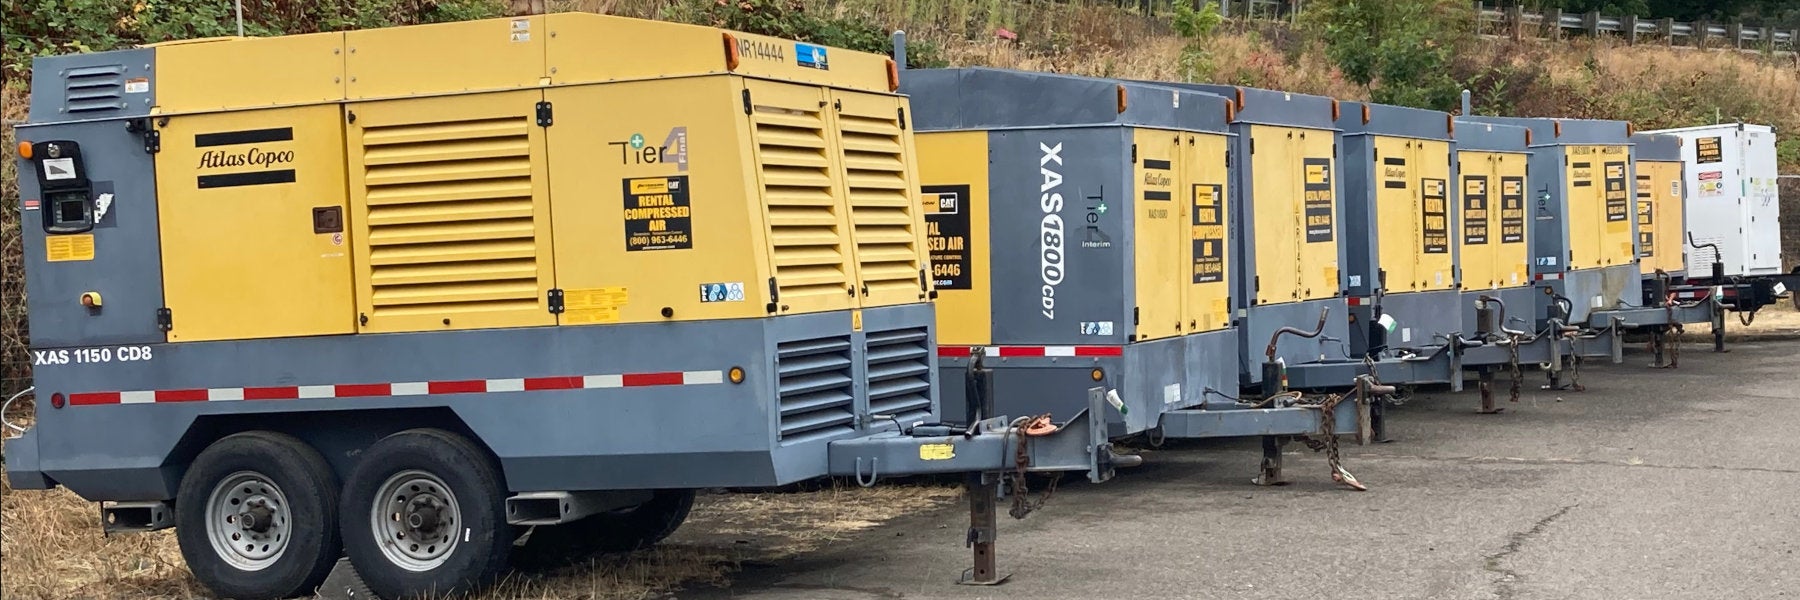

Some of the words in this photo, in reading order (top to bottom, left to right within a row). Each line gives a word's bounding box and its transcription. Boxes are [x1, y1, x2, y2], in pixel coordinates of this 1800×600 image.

[736, 38, 784, 62] NR14444
[608, 134, 667, 164] Tier
[196, 150, 246, 169] Atlas
[247, 148, 294, 168] Copco
[668, 181, 679, 190] CAT
[638, 194, 674, 207] RENTAL
[940, 198, 955, 208] CAT
[624, 206, 690, 220] COMPRESSED
[1086, 185, 1108, 232] Tier
[649, 219, 666, 231] AIR
[630, 236, 650, 246] (800)
[651, 234, 688, 244] 963-6446
[947, 237, 964, 250] AIR
[34, 350, 70, 365] XAS
[74, 348, 111, 363] 1150
[117, 346, 152, 361] CD8
